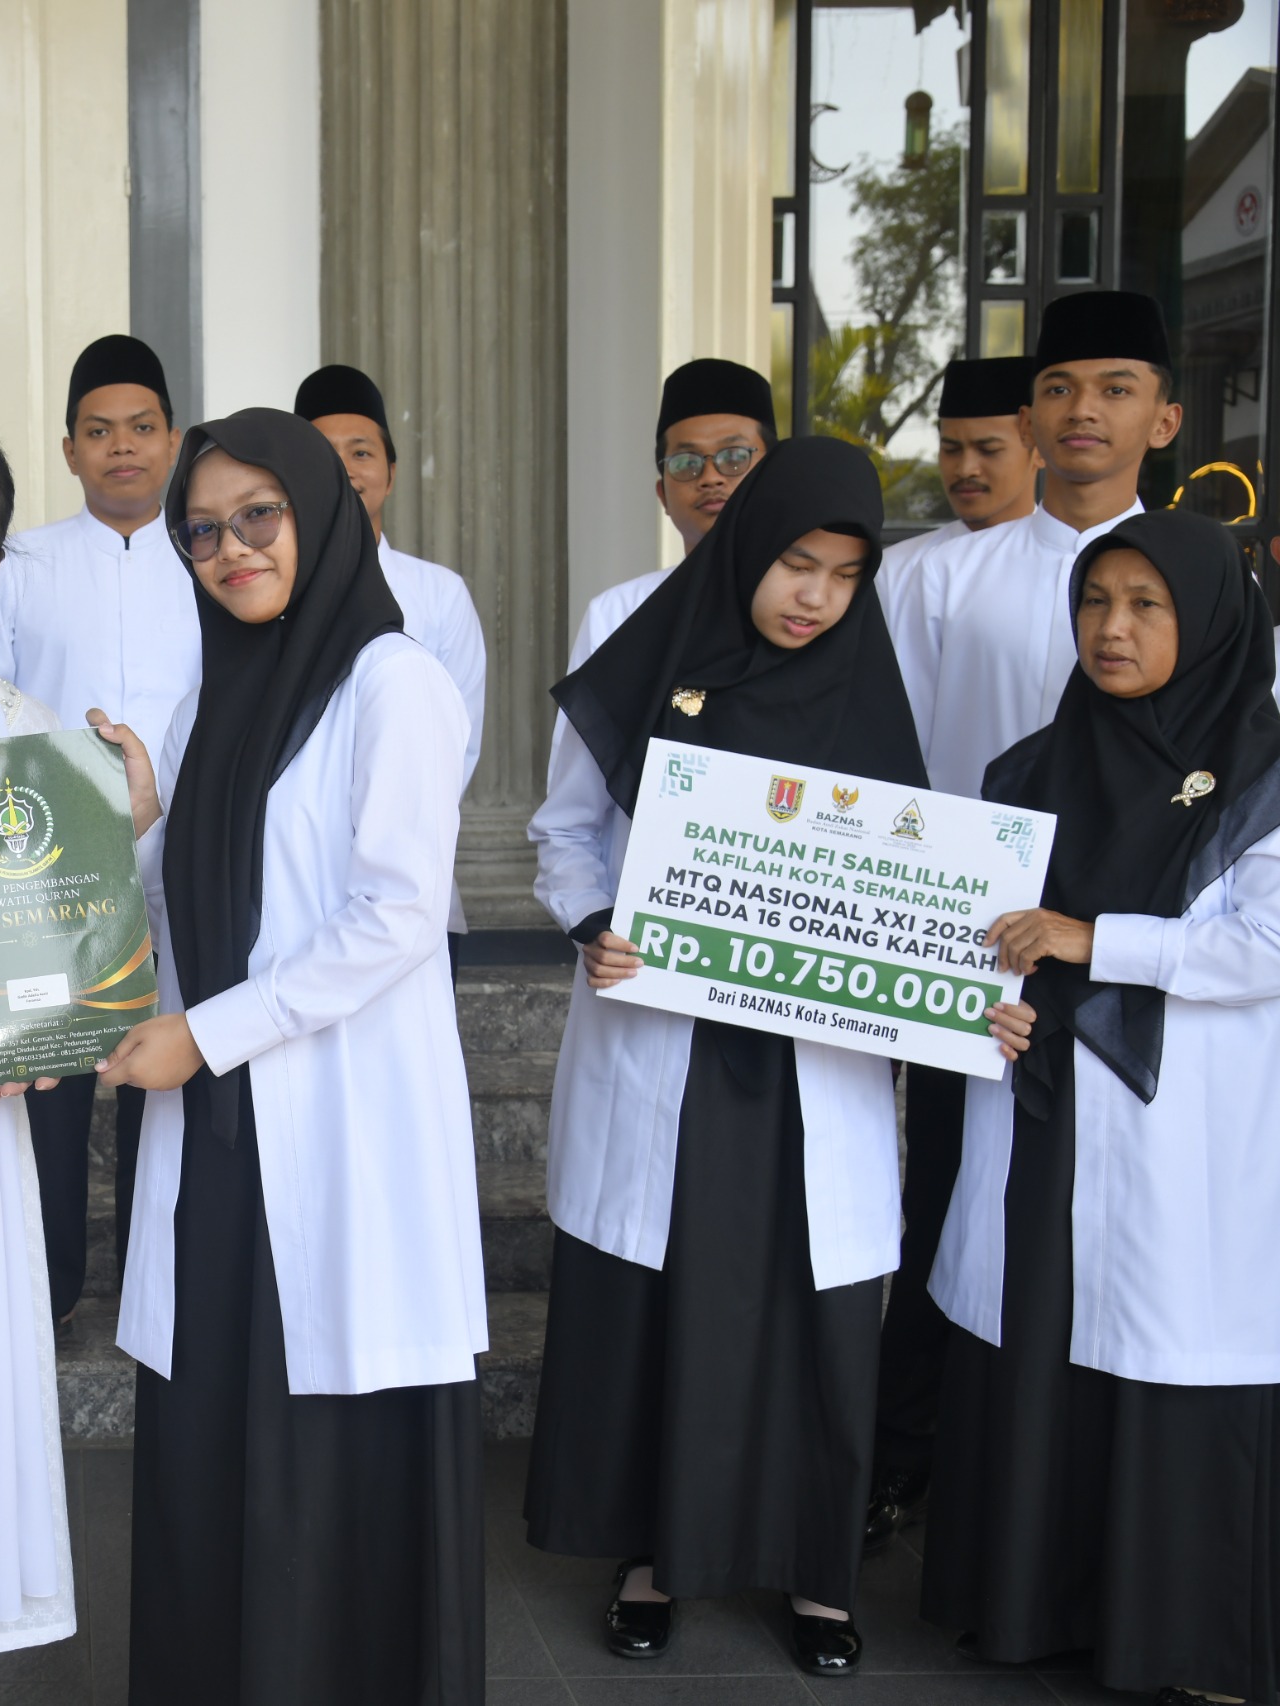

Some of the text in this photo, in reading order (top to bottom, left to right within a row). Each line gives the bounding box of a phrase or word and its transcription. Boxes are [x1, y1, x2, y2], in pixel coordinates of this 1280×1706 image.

[812, 826, 862, 840] KOTA SEMARANG
[816, 811, 864, 828] BAZNAS
[684, 821, 989, 897] BANTUAN FI SABILILLAH
[3, 873, 100, 895] PENGEMBANGAN
[35, 889, 80, 904] QUR'AN
[692, 847, 972, 916] KAFILAH KOTA SEMARANG
[1, 898, 117, 929] SEMARANG
[665, 866, 988, 947] MTQ NASIONAL XXI 2026
[648, 886, 998, 972] KEPADA 16 ORANG KAFILAH
[638, 921, 986, 1021] Rp. 10.750.000
[21, 1019, 59, 1031] Sekretariat
[708, 987, 899, 1043] Dari BAZNAS Kota Semarang
